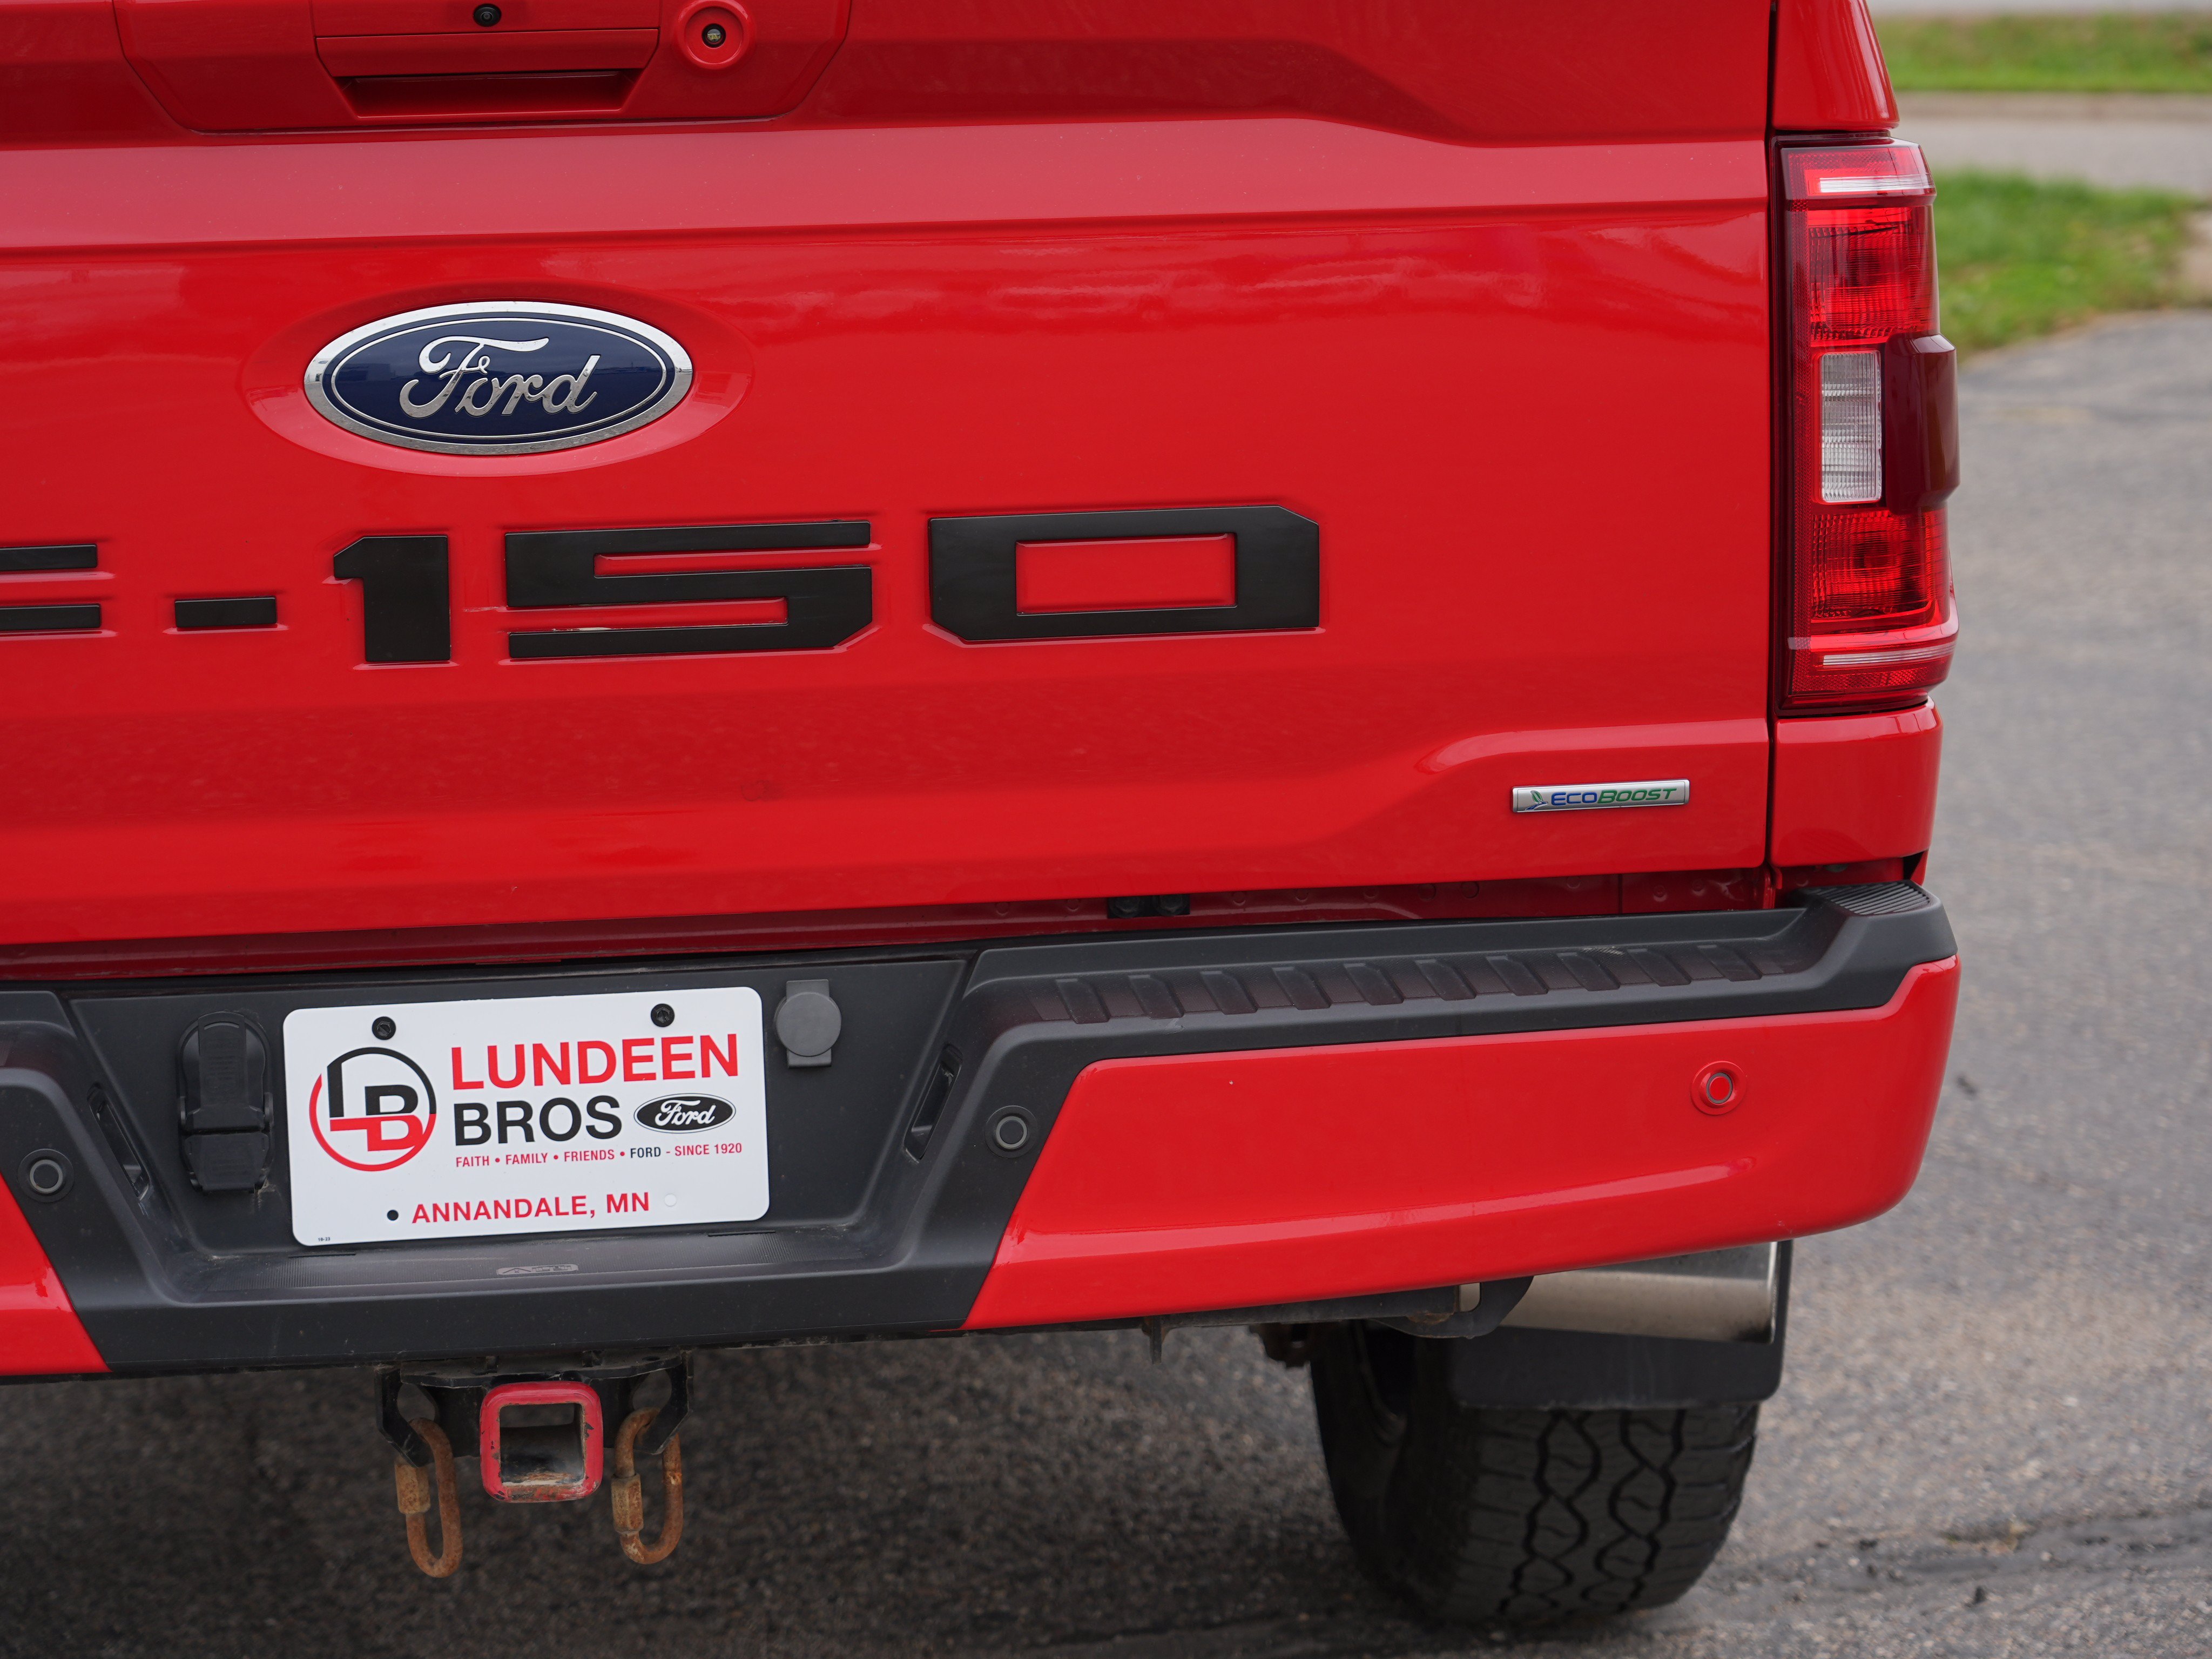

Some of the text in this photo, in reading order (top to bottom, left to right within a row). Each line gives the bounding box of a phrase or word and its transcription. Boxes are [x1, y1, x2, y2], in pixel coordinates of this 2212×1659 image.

[399, 335, 601, 417] Ford
[451, 1034, 738, 1090] LUNDEEN
[454, 1095, 622, 1146] BROS
[655, 1100, 716, 1127] Ford
[456, 1156, 489, 1168] FAITH
[505, 1152, 548, 1165] FAMILY
[564, 1149, 615, 1162] FRIENDS
[630, 1147, 661, 1158] FORD
[675, 1144, 710, 1156] SINCE
[714, 1143, 743, 1154] 1920
[412, 1192, 649, 1223] ANNANDALE, MN
